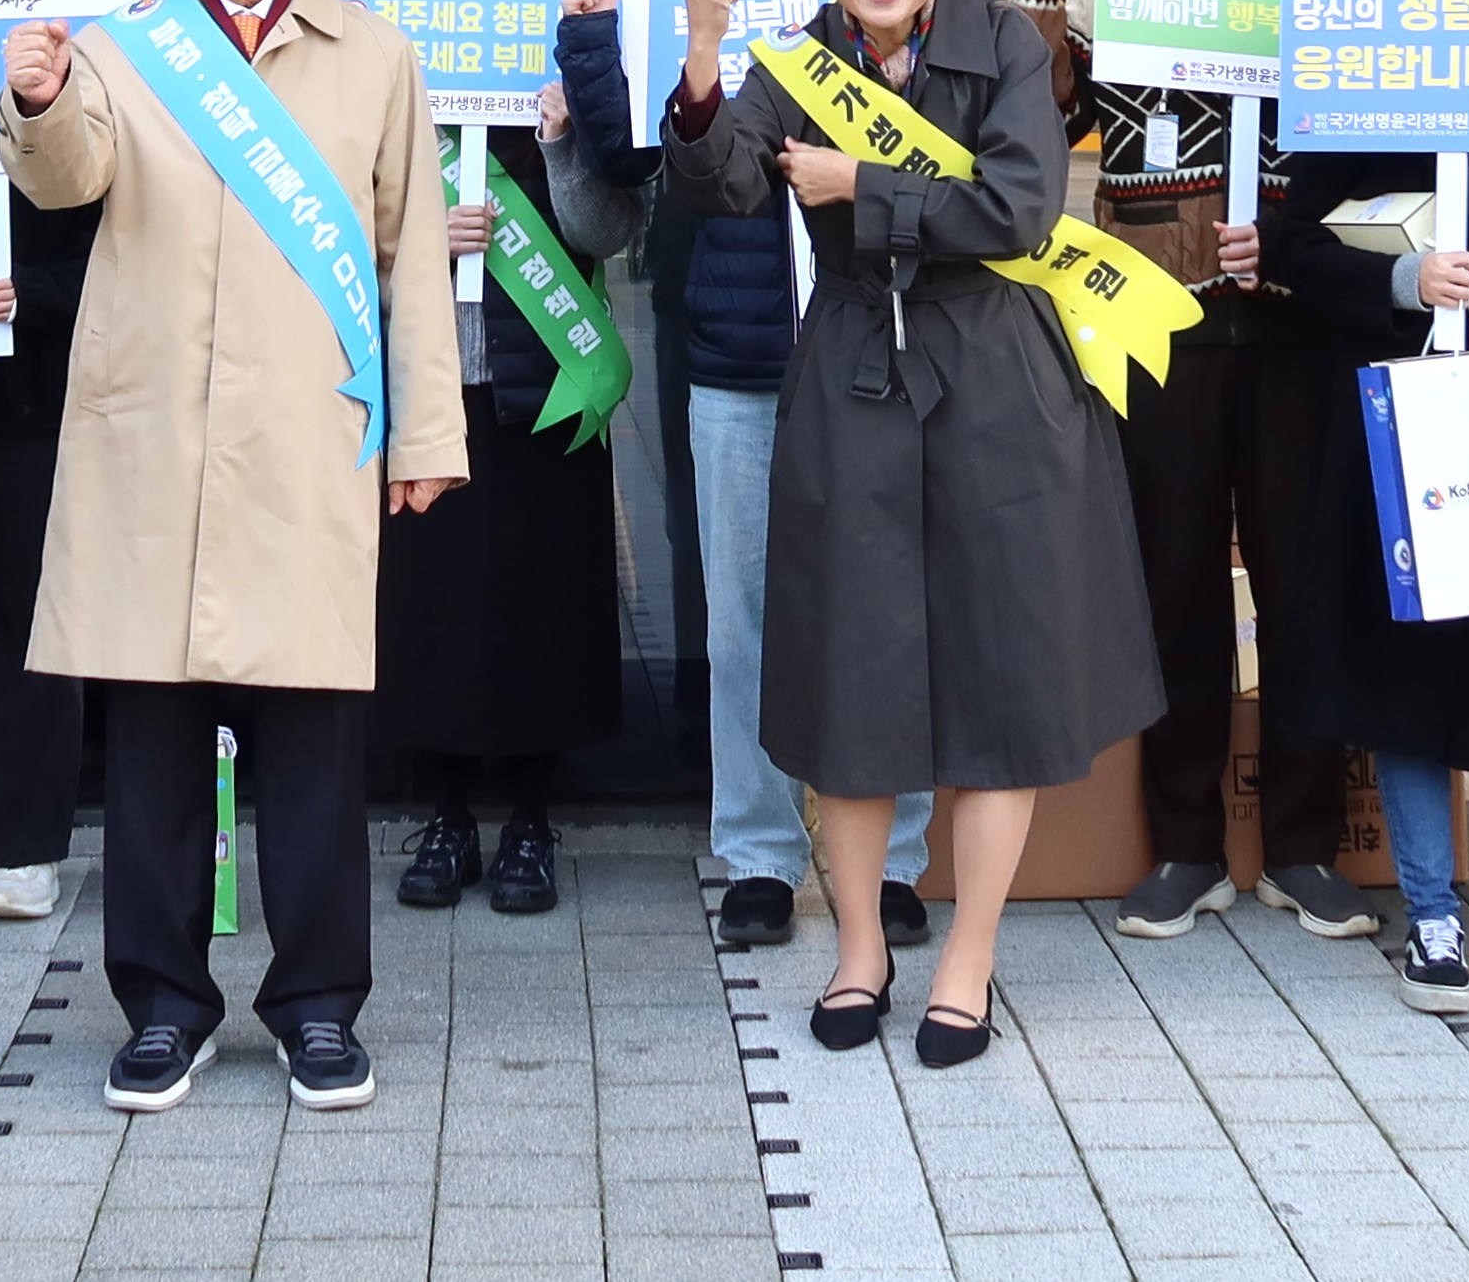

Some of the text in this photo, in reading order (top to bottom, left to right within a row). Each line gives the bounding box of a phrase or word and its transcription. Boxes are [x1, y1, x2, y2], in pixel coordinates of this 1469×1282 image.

[492, 1, 547, 36] 청렴
[491, 43, 547, 76] 부패
[145, 17, 203, 75] 부정
[199, 79, 259, 143] 청탁
[242, 135, 341, 255] 금품수수
[1328, 110, 1469, 131] 국가생명윤리정책원
